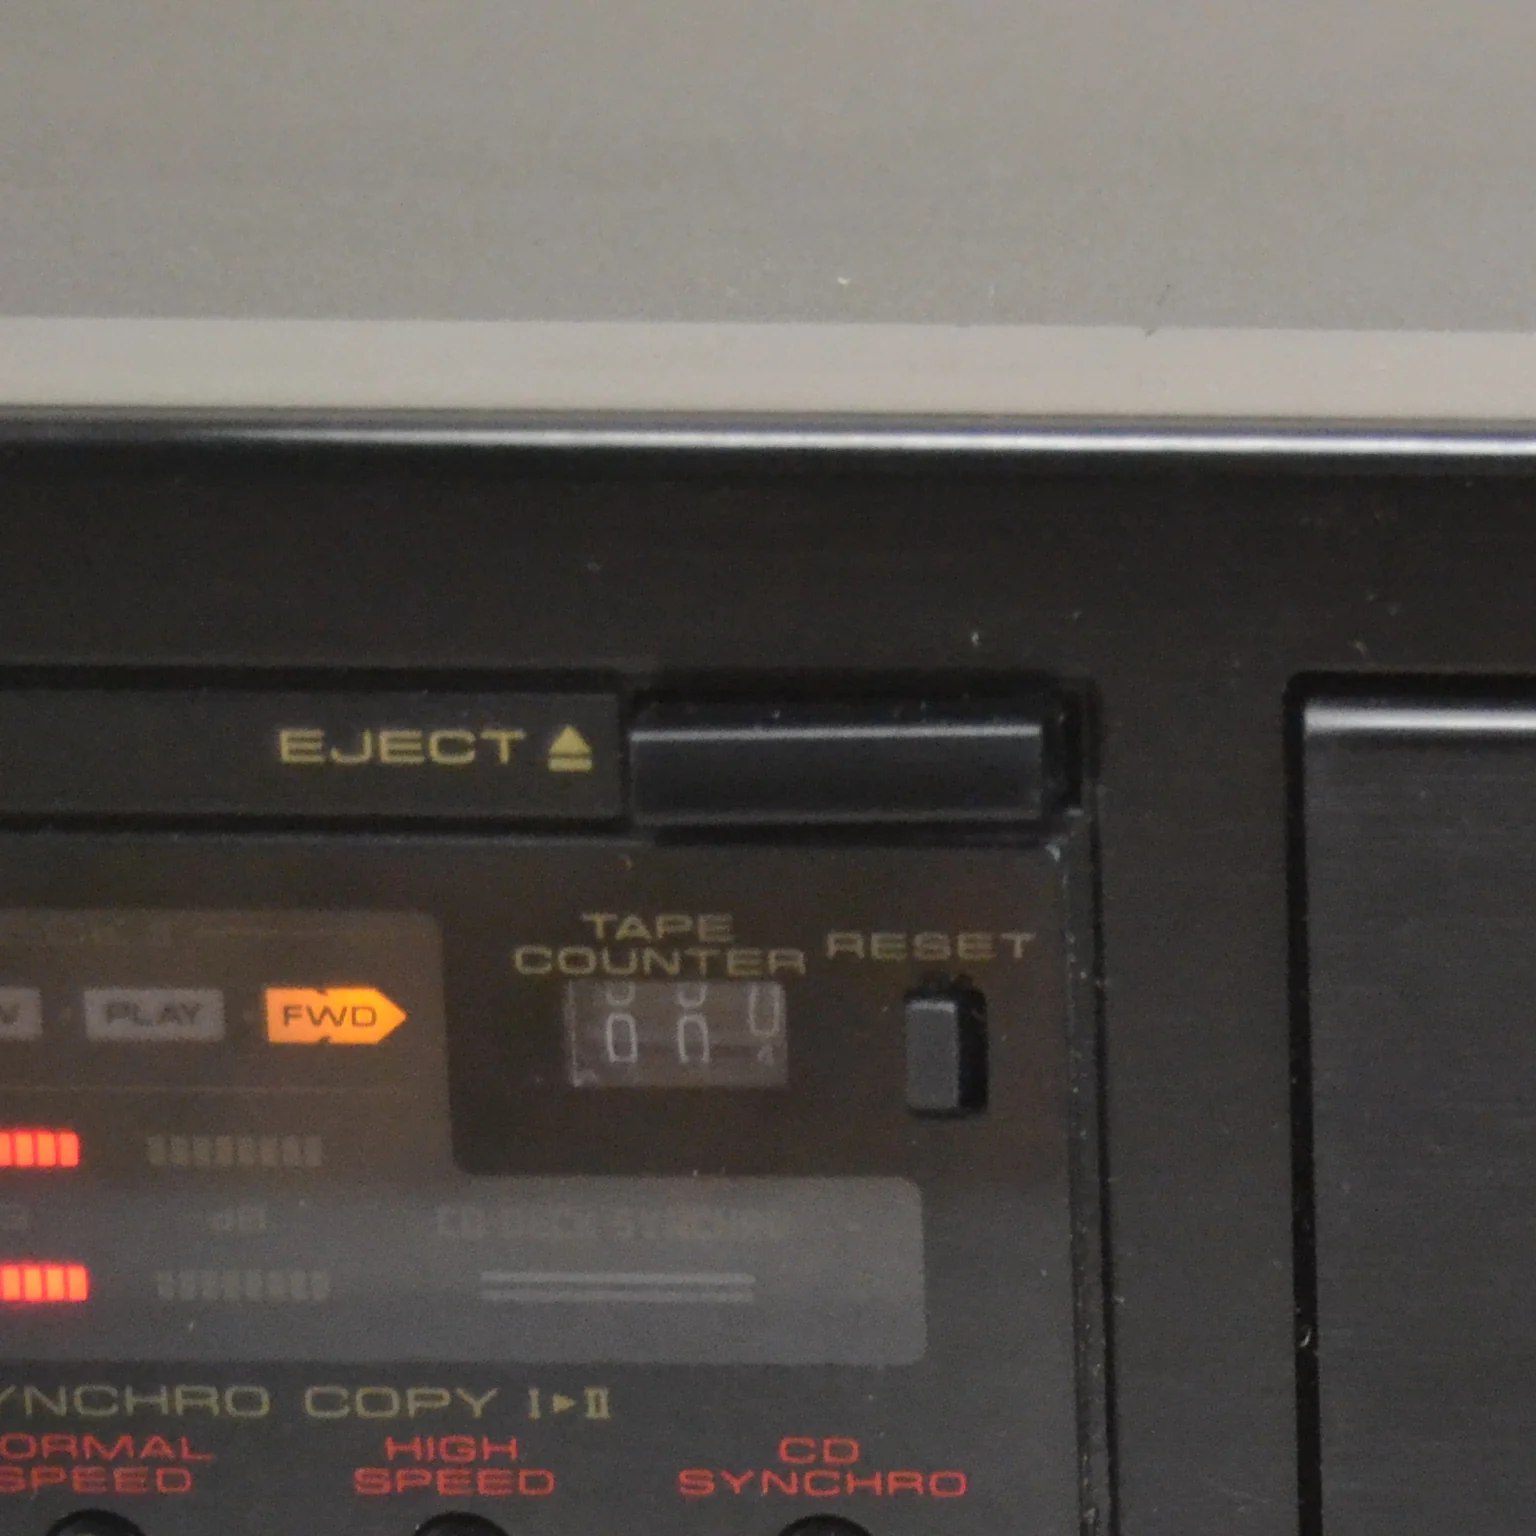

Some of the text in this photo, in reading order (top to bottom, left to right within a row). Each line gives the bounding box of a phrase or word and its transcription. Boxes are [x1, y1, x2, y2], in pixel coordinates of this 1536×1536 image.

[278, 728, 526, 765] EJECT
[581, 912, 731, 943] TAPE
[512, 945, 806, 977] COUNTER
[826, 931, 1036, 961] RESET
[103, 1000, 202, 1027] PLAY
[280, 1003, 377, 1029] FWD
[303, 1385, 498, 1419] COPY
[0, 1432, 210, 1462] ORMAL
[384, 1435, 519, 1464] HIGH
[777, 1436, 861, 1466] CD
[0, 1464, 193, 1494] SPEED
[353, 1466, 556, 1497] SPEED
[677, 1468, 969, 1498] SYNCHRO
